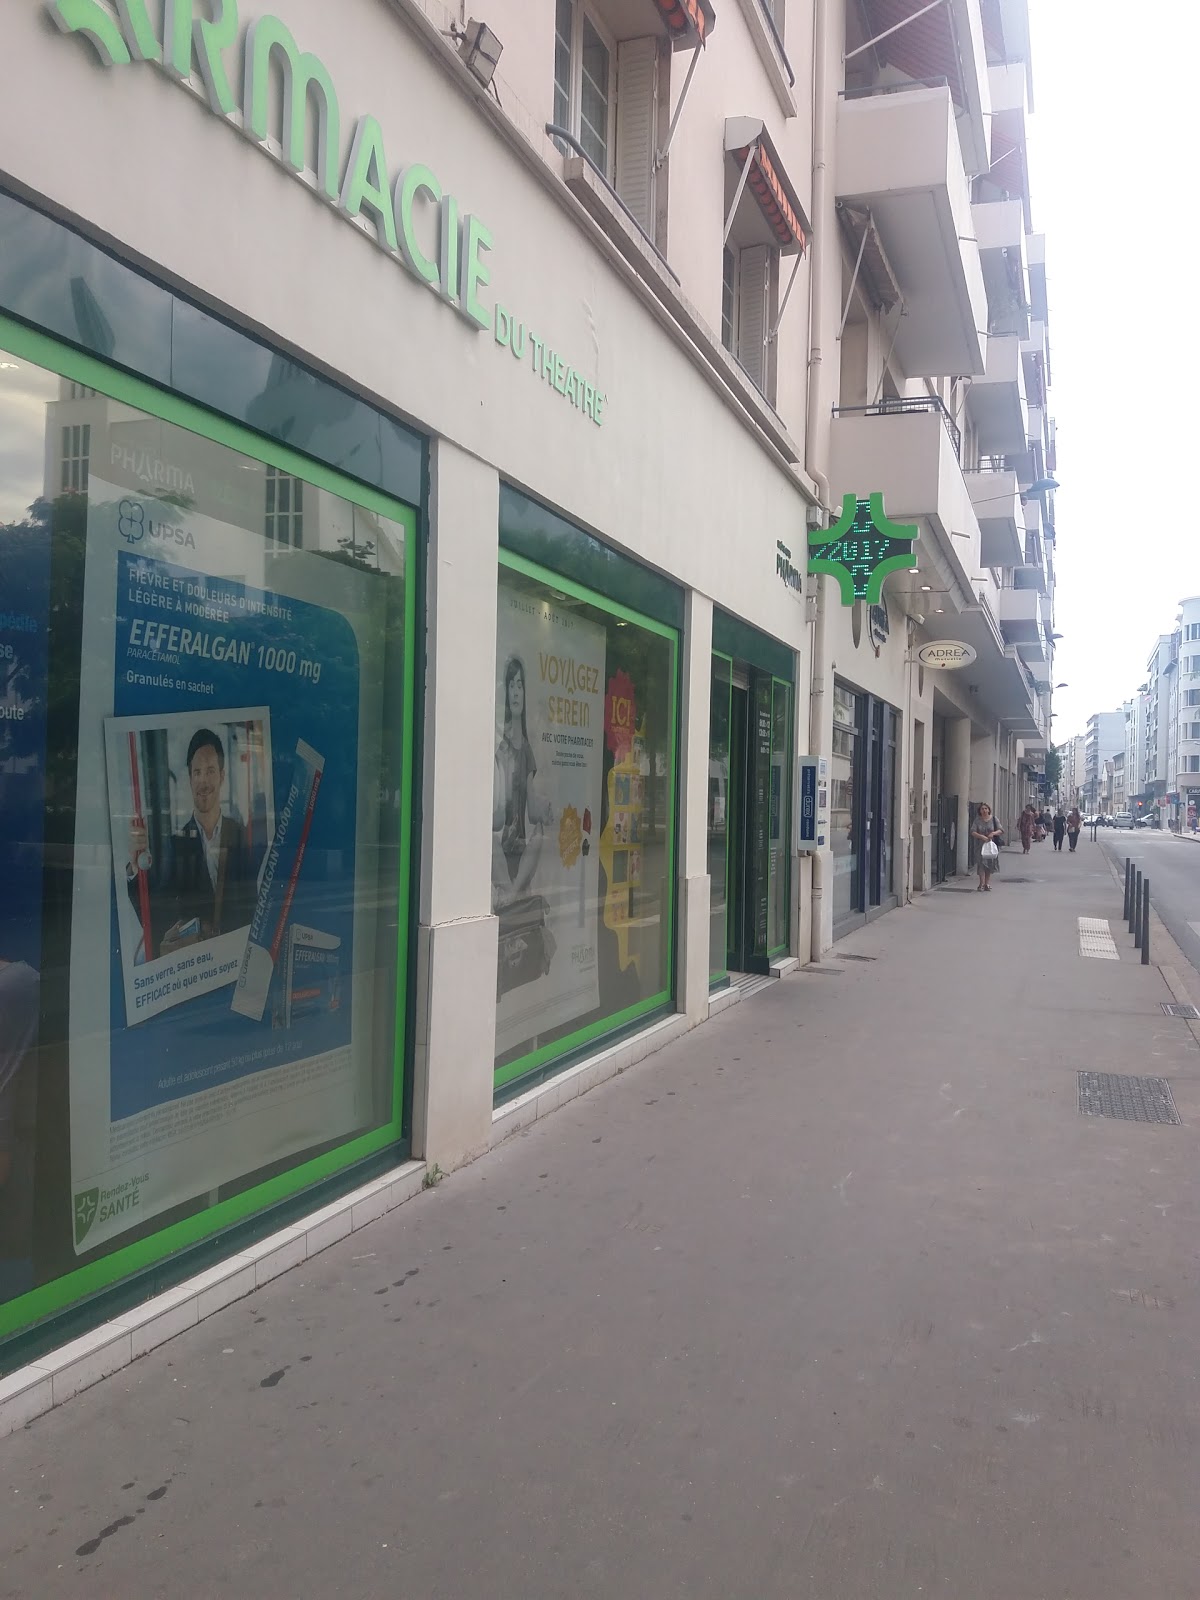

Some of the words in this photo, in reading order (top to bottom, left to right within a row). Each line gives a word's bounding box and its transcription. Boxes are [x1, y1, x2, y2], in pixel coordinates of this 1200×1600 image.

[495, 302, 525, 359] DU
[529, 331, 604, 427] THEATRE
[148, 520, 195, 549] UPSA
[129, 567, 170, 590] FIÈVRE
[172, 577, 185, 592] ET
[187, 583, 237, 607] DOULEURS
[128, 588, 173, 611] LÉGÈRE
[175, 597, 182, 611] À
[185, 603, 230, 624] MODÉRÉE
[258, 646, 296, 674] 1000
[299, 659, 321, 684] mg
[927, 648, 971, 658] ADREA
[126, 670, 174, 689] Granulés
[175, 679, 187, 691] en
[187, 680, 214, 695] sachet
[538, 652, 599, 694] VOYAGEZ
[548, 695, 590, 728] SEREIN
[610, 695, 631, 727] ICI
[541, 732, 553, 743] AVEC
[249, 848, 281, 940] EFFERALGAN
[276, 806, 293, 843] 1000
[286, 783, 300, 808] mg
[134, 974, 155, 990] Sans
[155, 964, 176, 980] verre,
[177, 957, 195, 972] sans
[196, 952, 214, 964] eau,
[242, 946, 254, 975] UPSA
[135, 983, 171, 1009] EFFICACE
[172, 980, 181, 991] où
[183, 975, 198, 988] que
[199, 967, 218, 980] vous
[218, 959, 238, 974] soyez
[100, 1172, 150, 1202] Rendez-Vous
[100, 1186, 140, 1222] SANTÉ
